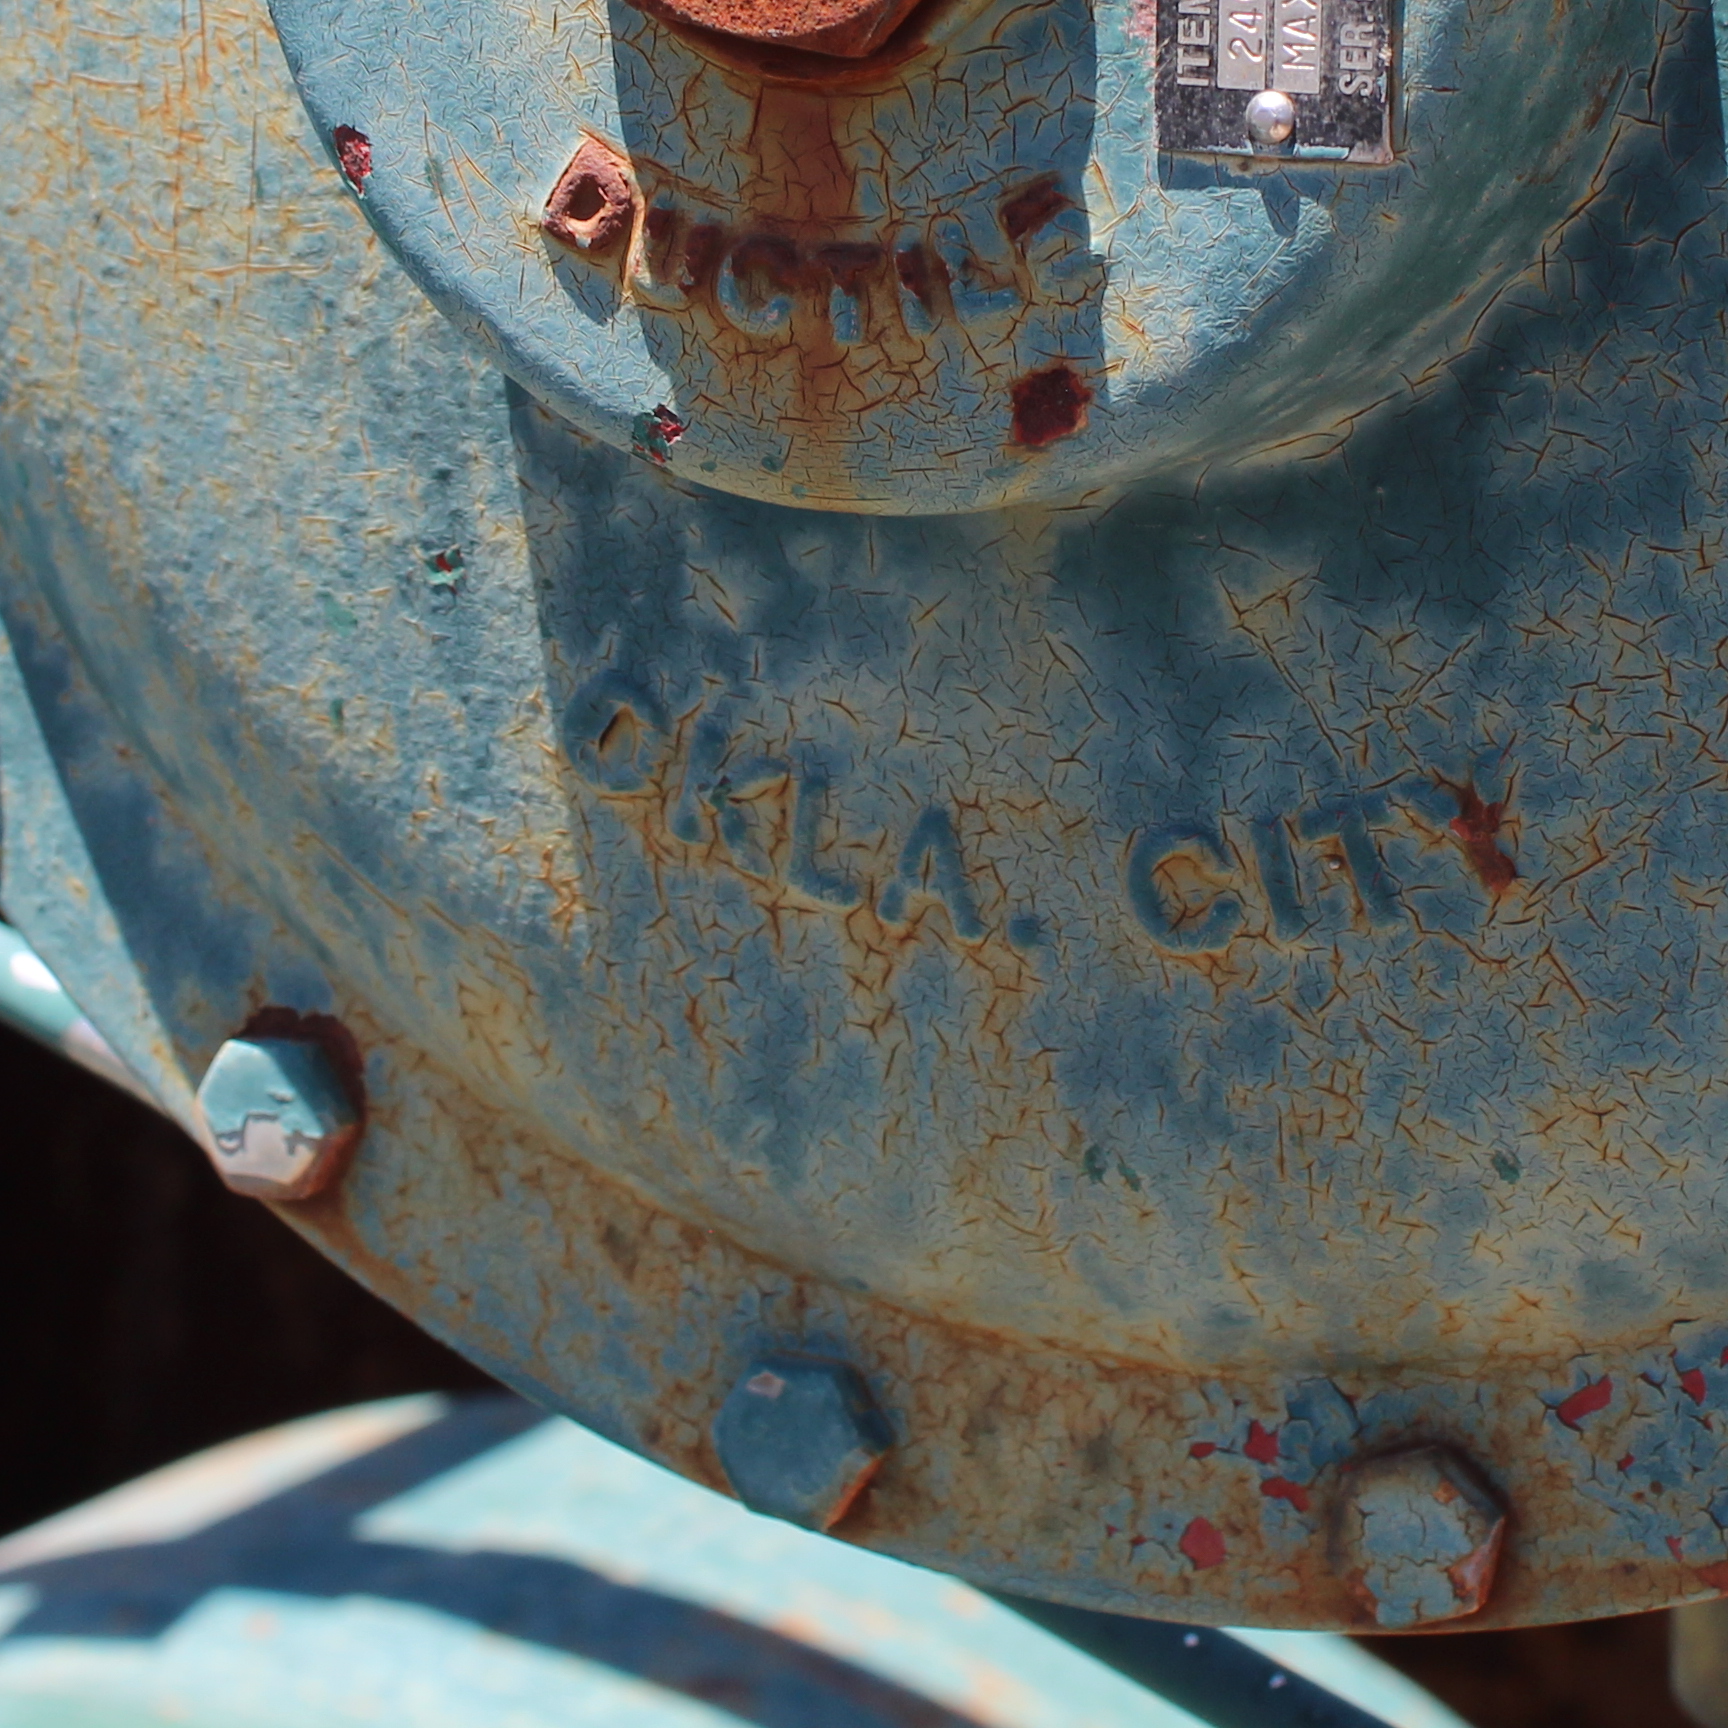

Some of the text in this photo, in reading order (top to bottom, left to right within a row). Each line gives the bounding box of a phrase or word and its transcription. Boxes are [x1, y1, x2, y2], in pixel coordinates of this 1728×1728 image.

[1337, 13, 1377, 96] SER.
[560, 672, 1519, 954] OKLA. CITY
